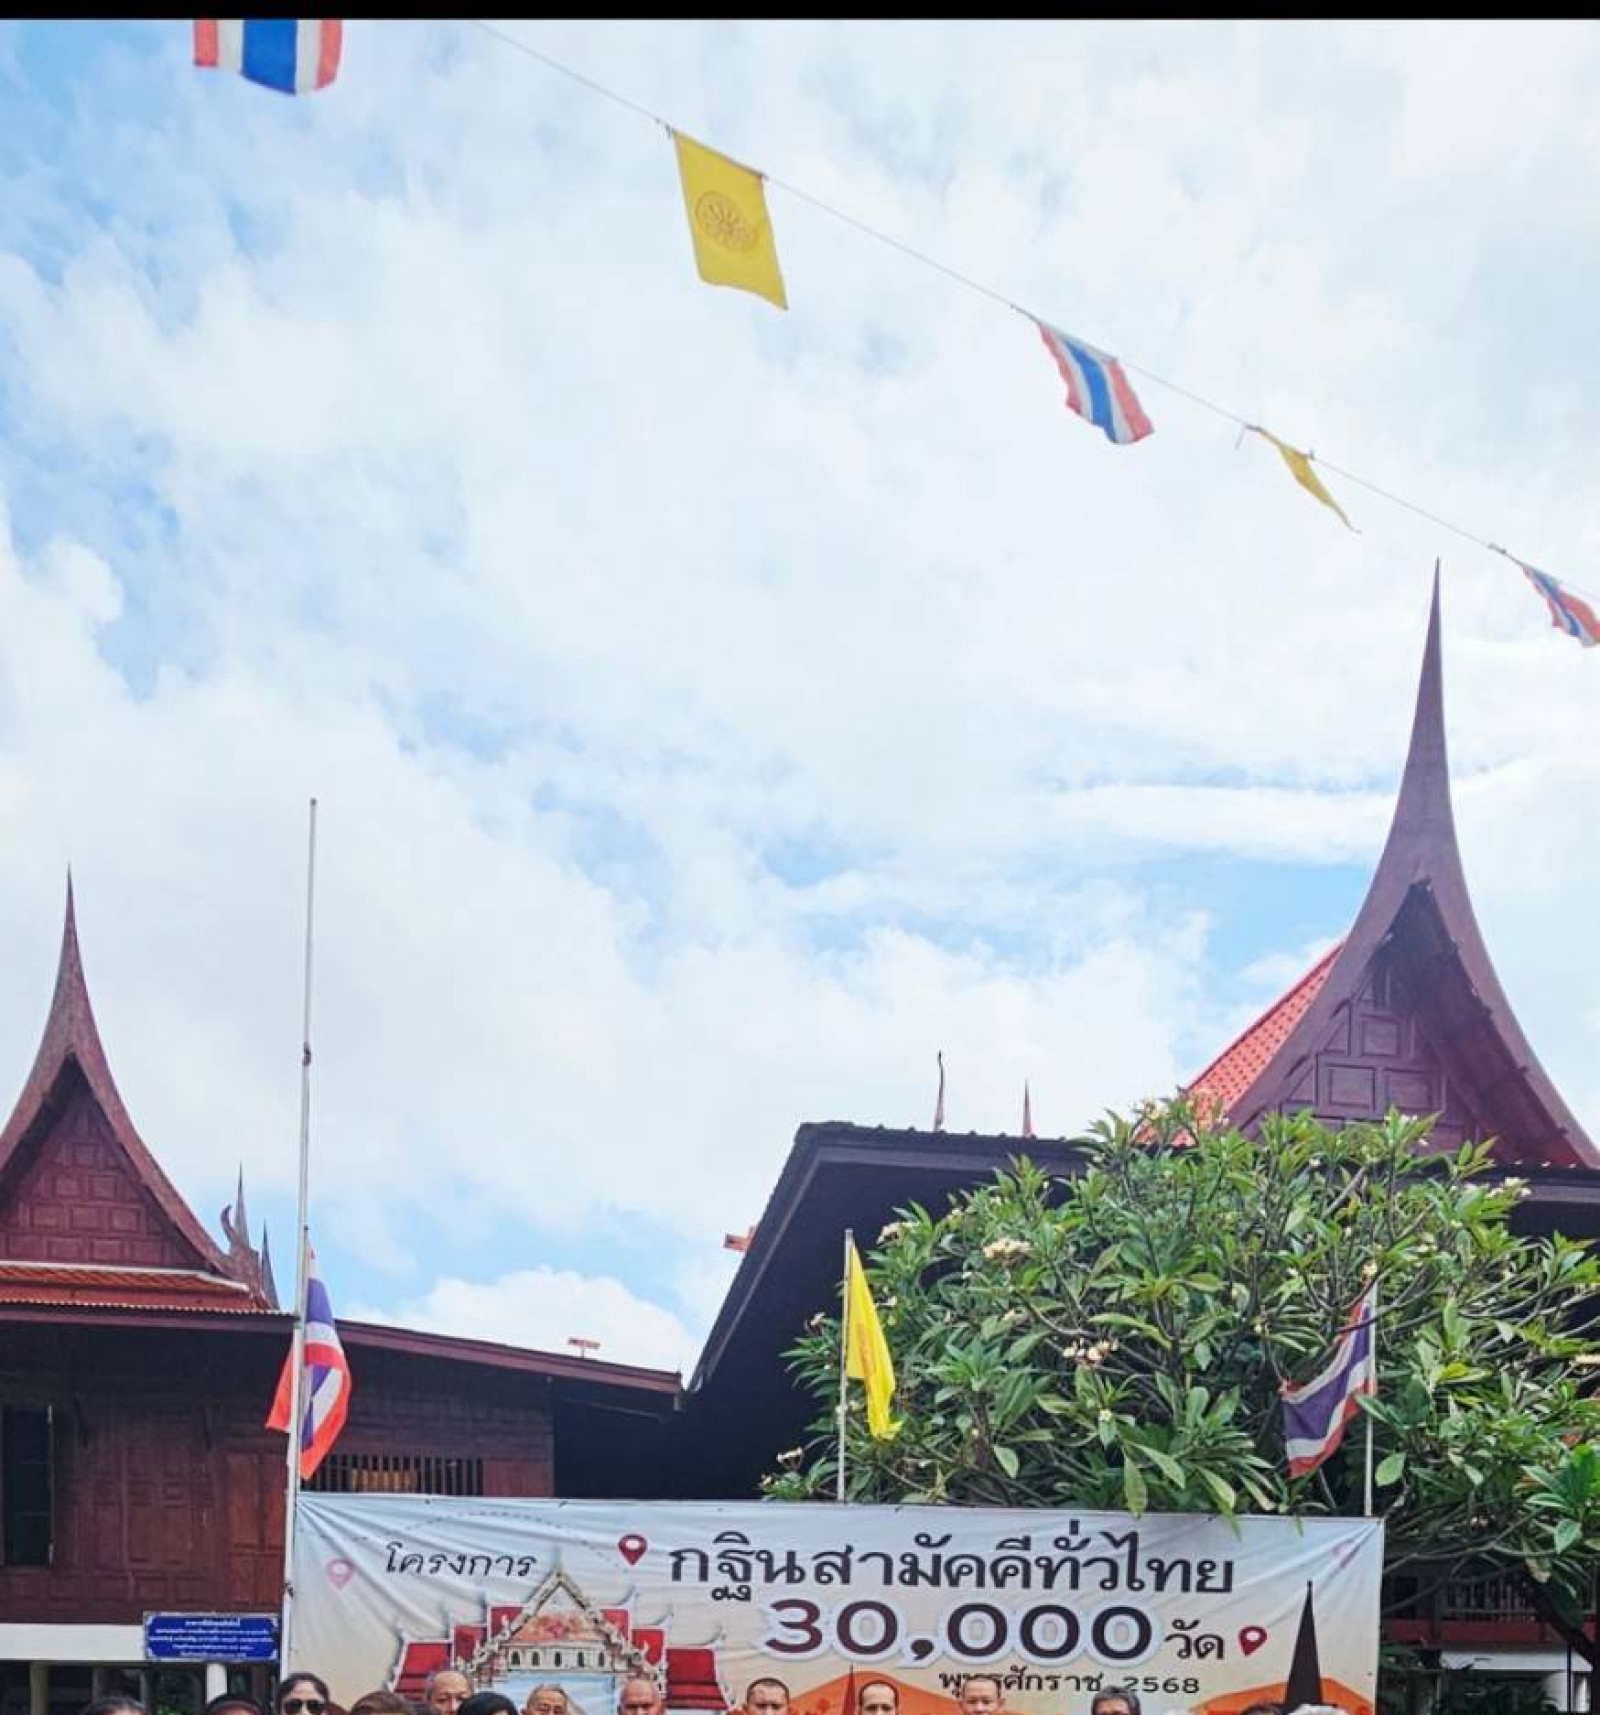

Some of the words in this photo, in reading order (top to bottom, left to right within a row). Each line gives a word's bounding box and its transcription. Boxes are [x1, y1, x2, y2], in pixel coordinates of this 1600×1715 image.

[385, 1542, 537, 1577] โครงการ
[669, 1519, 1233, 1601] กฐินสามัคคีทั่วไทย
[765, 1599, 1153, 1661] 30,000
[1164, 1618, 1225, 1660] วัด
[938, 1664, 1103, 1698] พุศักราช
[1122, 1676, 1200, 1694] 2568
